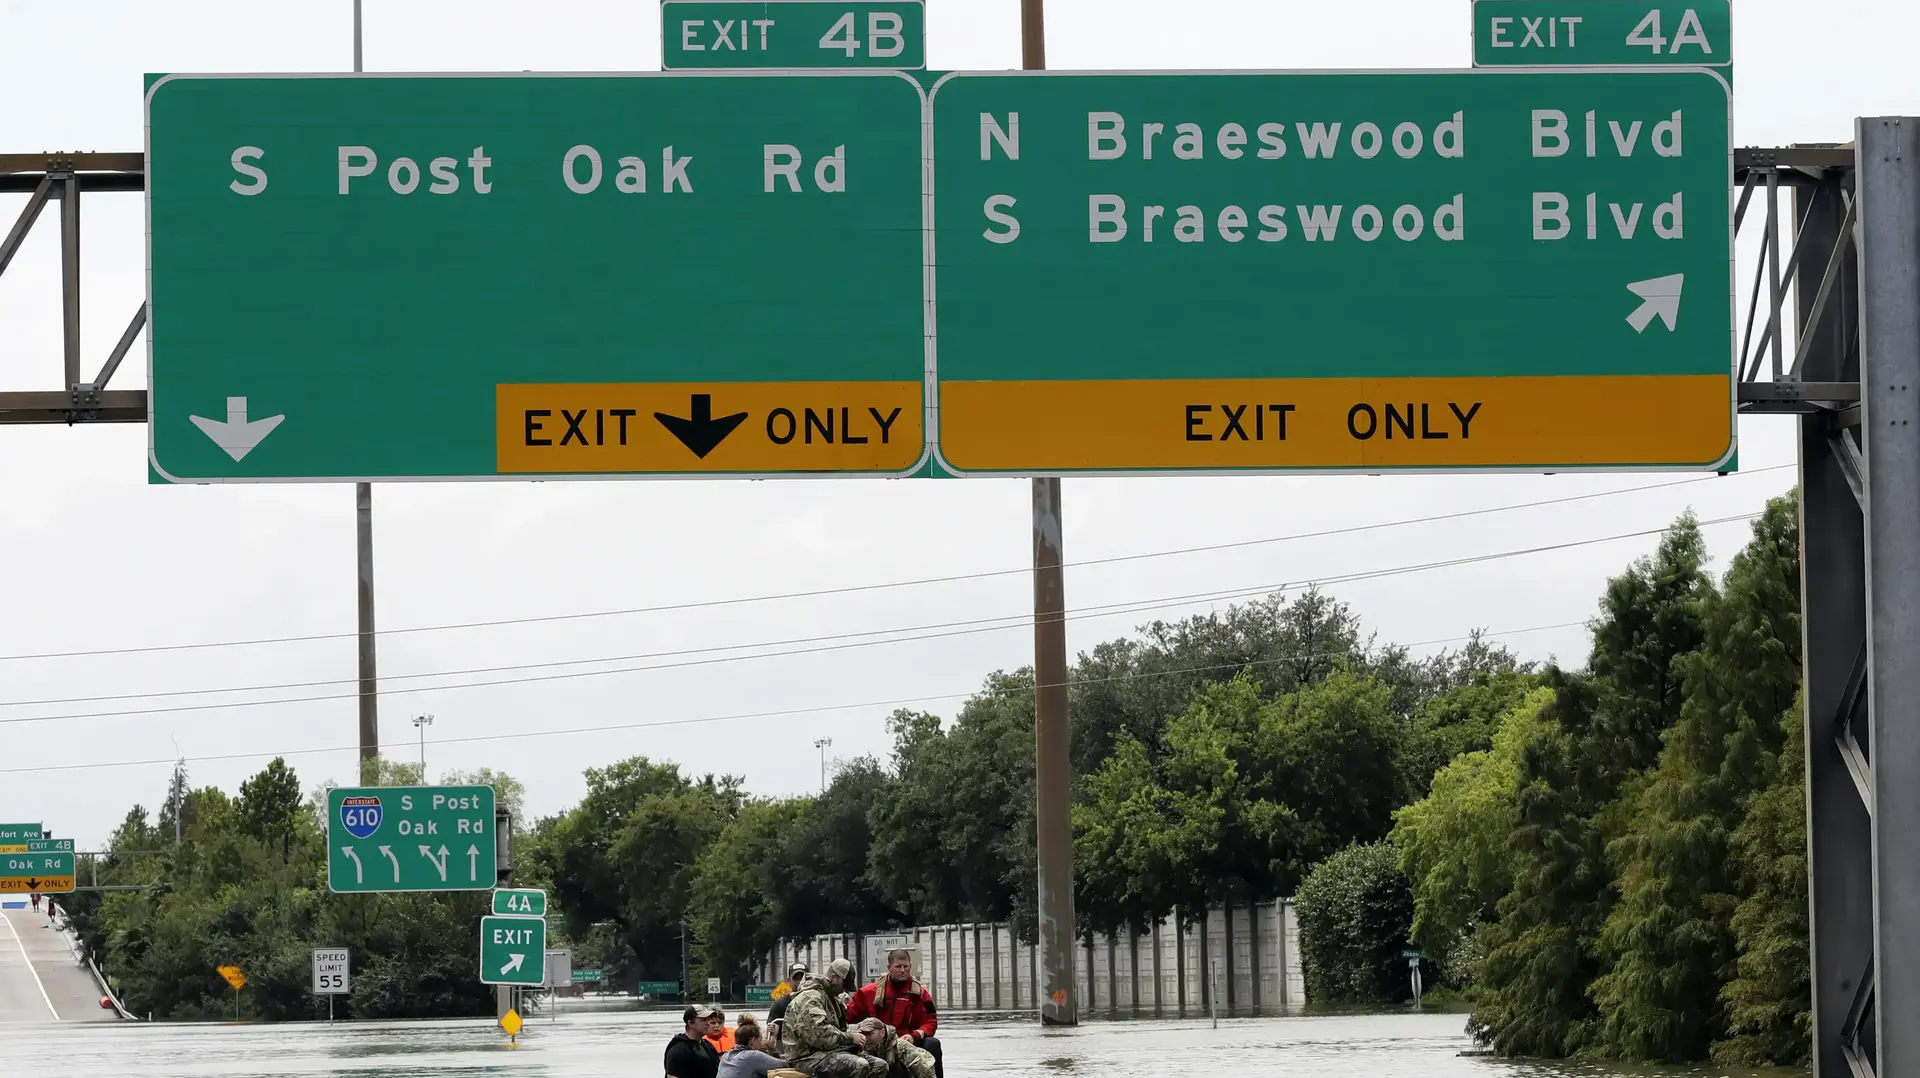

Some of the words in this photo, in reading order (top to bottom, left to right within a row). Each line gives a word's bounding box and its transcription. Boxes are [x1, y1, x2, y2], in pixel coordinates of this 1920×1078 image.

[682, 19, 775, 52] EXIT
[819, 12, 906, 58] 4B
[1491, 17, 1583, 48] EXIT
[1625, 9, 1713, 54] 4A
[980, 112, 1019, 160] N
[1089, 111, 1464, 160] Braeswood
[1532, 110, 1682, 158] Blvd
[229, 147, 268, 196] S
[338, 146, 492, 195] Post
[562, 145, 694, 195] Oak
[763, 144, 846, 193] Rd
[982, 194, 1021, 244] S
[1089, 194, 1464, 242] Braeswood
[1532, 192, 1683, 240] Blvd
[524, 408, 637, 447] EXIT
[766, 406, 903, 445] ONLY
[1185, 404, 1296, 442] EXIT
[1347, 402, 1483, 441] ONLY
[401, 795, 413, 811] S
[433, 794, 479, 810] Post
[345, 808, 378, 827] 610
[398, 819, 438, 836] Oak
[457, 818, 483, 834] Rd
[30, 842, 48, 850] EXIT
[55, 840, 71, 850] 4B
[9, 859, 34, 869] Oak
[45, 858, 61, 869] Rd
[1, 880, 22, 889] EXIT
[44, 879, 70, 888] ONLY
[507, 894, 532, 912] 4A
[493, 928, 533, 945] EXIT
[316, 953, 347, 962] SPEED
[319, 964, 342, 972] LIMIT
[320, 974, 343, 989] 55
